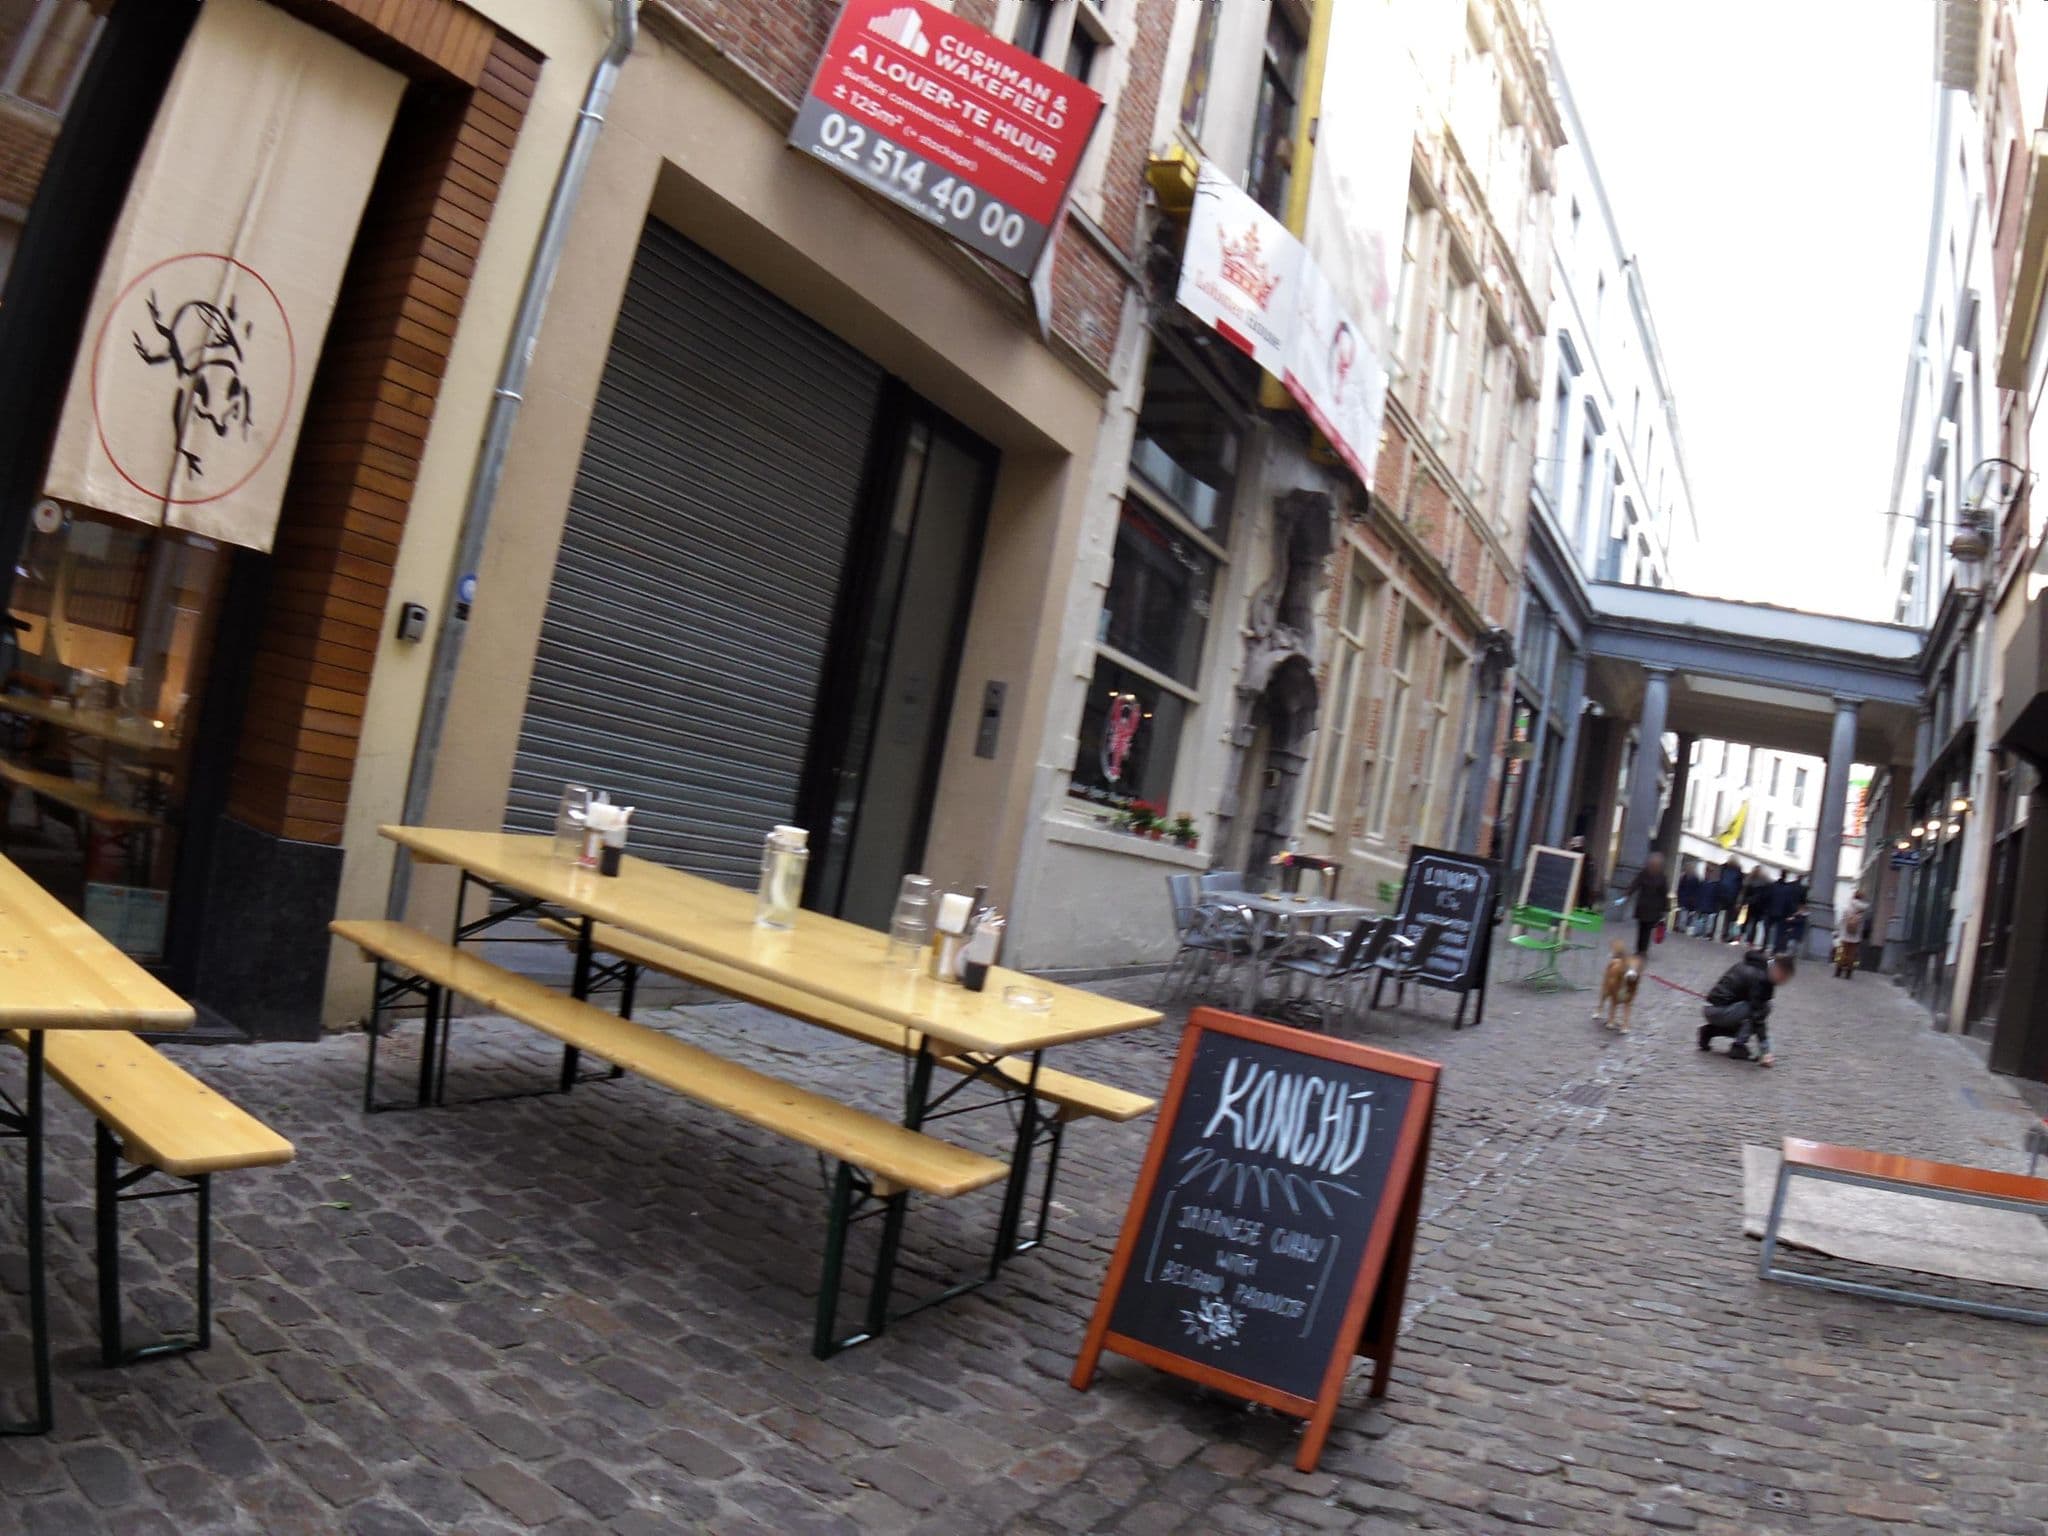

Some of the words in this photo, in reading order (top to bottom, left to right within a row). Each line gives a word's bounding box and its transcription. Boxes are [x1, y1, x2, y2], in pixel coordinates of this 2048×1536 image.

[849, 44, 868, 65] A
[872, 54, 992, 128] LOUER-TE
[992, 118, 1057, 167] HUUR
[934, 49, 1065, 130] WAKEFIELD
[938, 35, 1051, 102] CUSHMAN
[1052, 95, 1069, 114] &
[820, 113, 867, 161] 02
[868, 138, 927, 194] 514
[929, 176, 976, 219] 40
[979, 201, 1025, 248] 00
